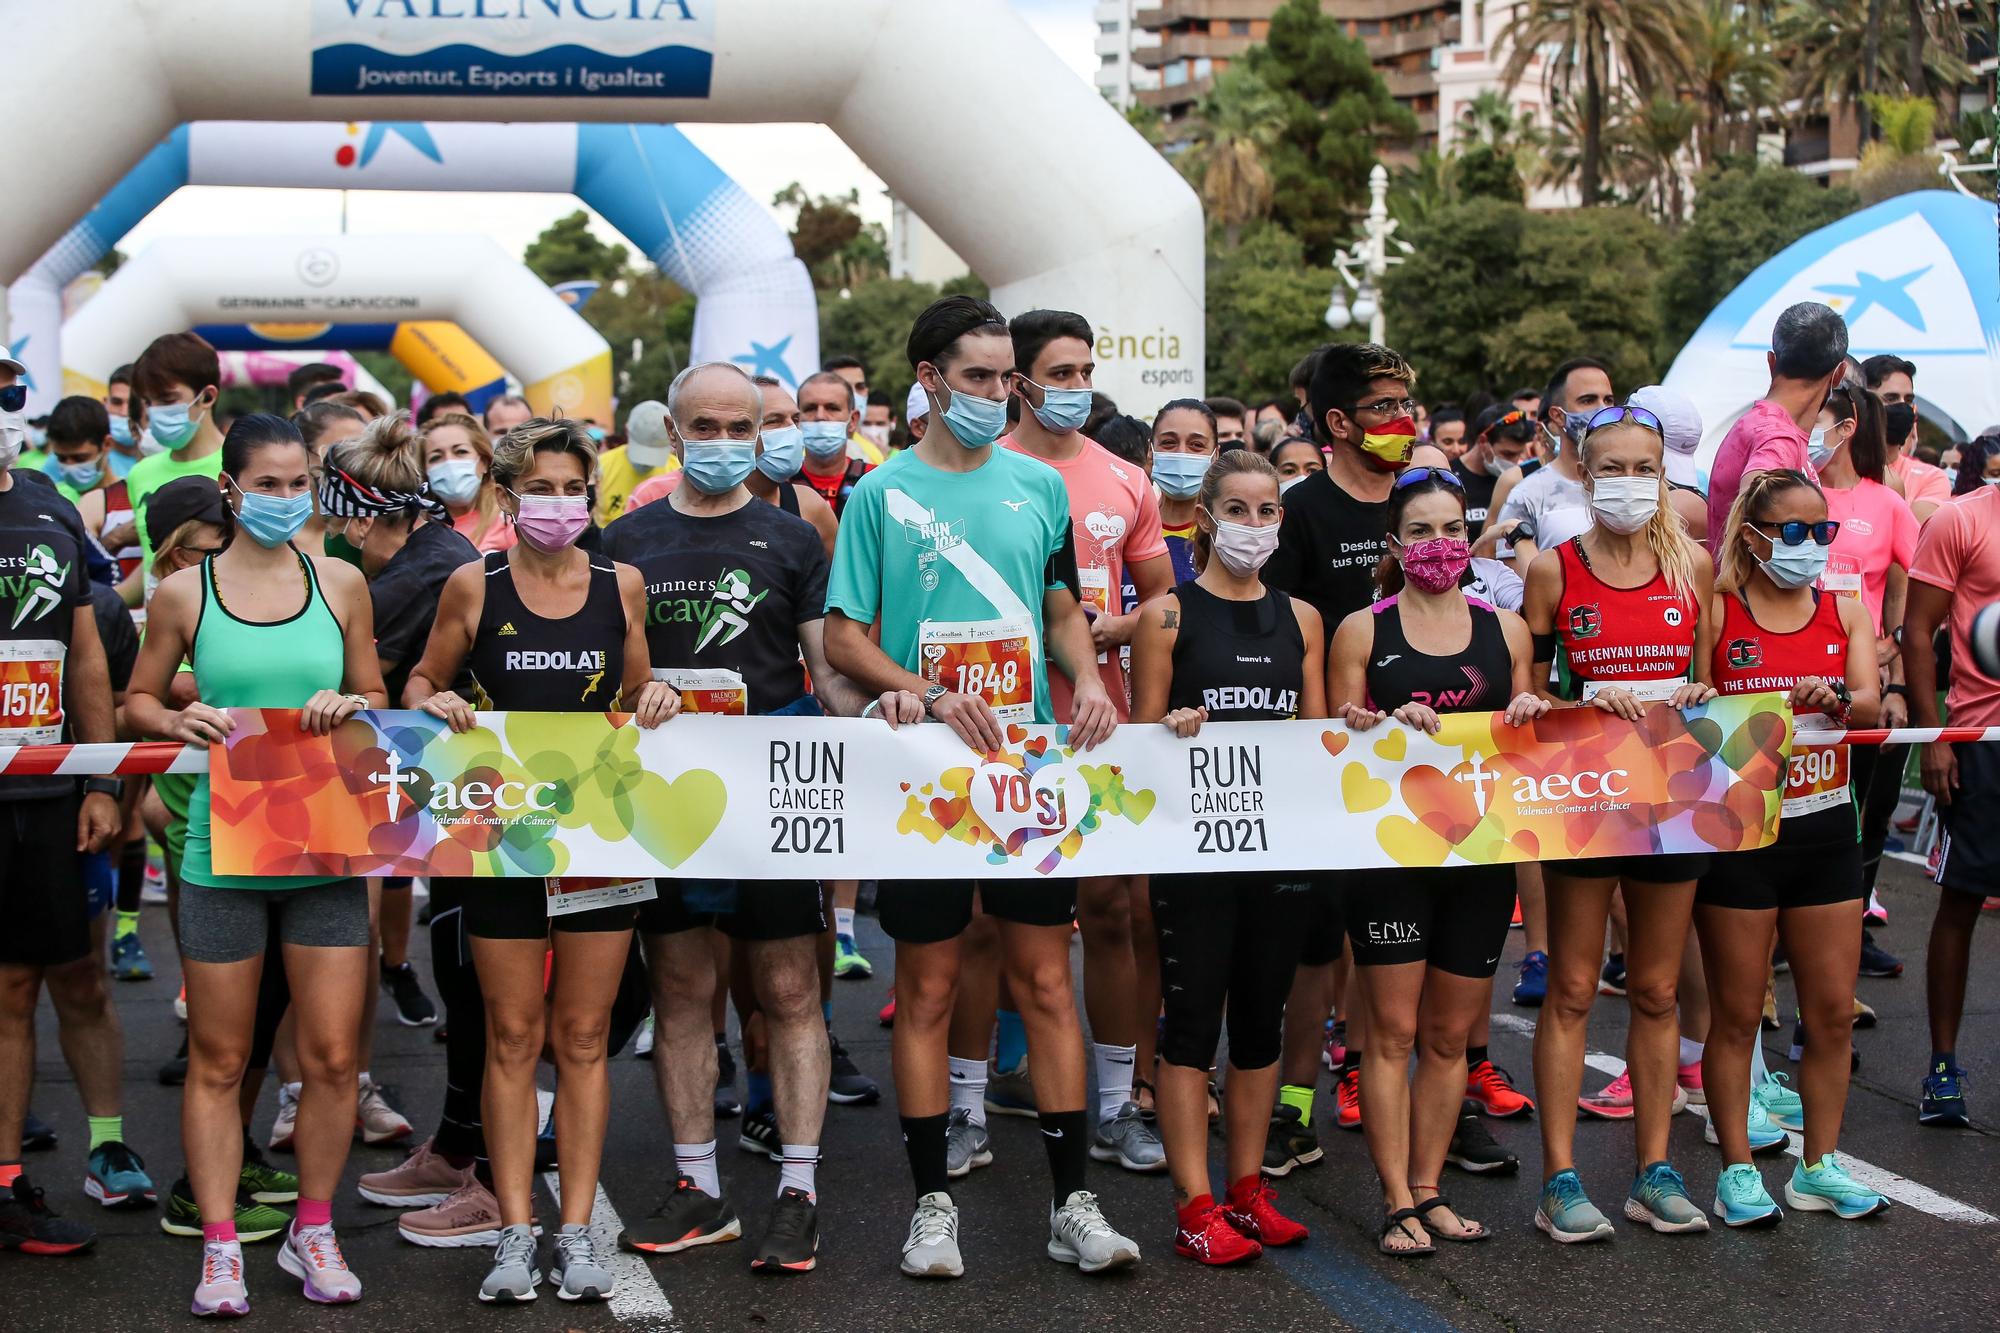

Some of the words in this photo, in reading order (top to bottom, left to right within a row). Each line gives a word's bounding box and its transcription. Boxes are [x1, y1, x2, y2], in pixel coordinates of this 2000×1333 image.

[357, 64, 463, 89] Joventut,
[468, 65, 558, 88] Esports
[564, 67, 573, 85] i
[579, 66, 666, 90] Igualtat
[1141, 368, 1194, 387] esports
[1090, 521, 1123, 537] aecc
[1340, 539, 1378, 553] Desde
[1332, 557, 1352, 569] tus
[1355, 553, 1380, 567] ojos
[505, 651, 600, 671] REDOLAT
[1236, 654, 1263, 663] luanvi
[1571, 650, 1588, 664] THE
[1588, 645, 1633, 662] KENYAN
[1635, 644, 1674, 658] URBAN
[1675, 644, 1692, 657] WAY
[956, 660, 1018, 697] 1848
[1592, 663, 1635, 675] RAQUEL
[1636, 660, 1675, 672] LANDÍN
[1723, 679, 1744, 692] THE
[1746, 676, 1794, 689] KENYAN
[1796, 675, 1836, 687] UAN
[1, 682, 50, 717] 1512
[1202, 686, 1299, 712] REDOLAT
[769, 740, 844, 785] RUN
[1189, 745, 1262, 789] RUN
[1785, 749, 1836, 789] 390
[430, 781, 557, 811] aecc
[769, 784, 844, 810] CÁNCER
[987, 774, 1031, 813] YO
[1511, 769, 1629, 803] aecc
[1191, 788, 1264, 814] CÁNCER
[1516, 805, 1553, 817] Valencia
[1555, 803, 1587, 815] Contra
[1589, 801, 1598, 813] el
[1599, 799, 1632, 812] Cáncer
[432, 813, 471, 826] Valencia
[473, 813, 508, 826] Contra
[510, 814, 520, 826] el
[522, 813, 557, 827] Cáncer
[770, 815, 844, 854] 2021
[1194, 818, 1268, 853] 2021
[1368, 921, 1420, 942] ENIX
